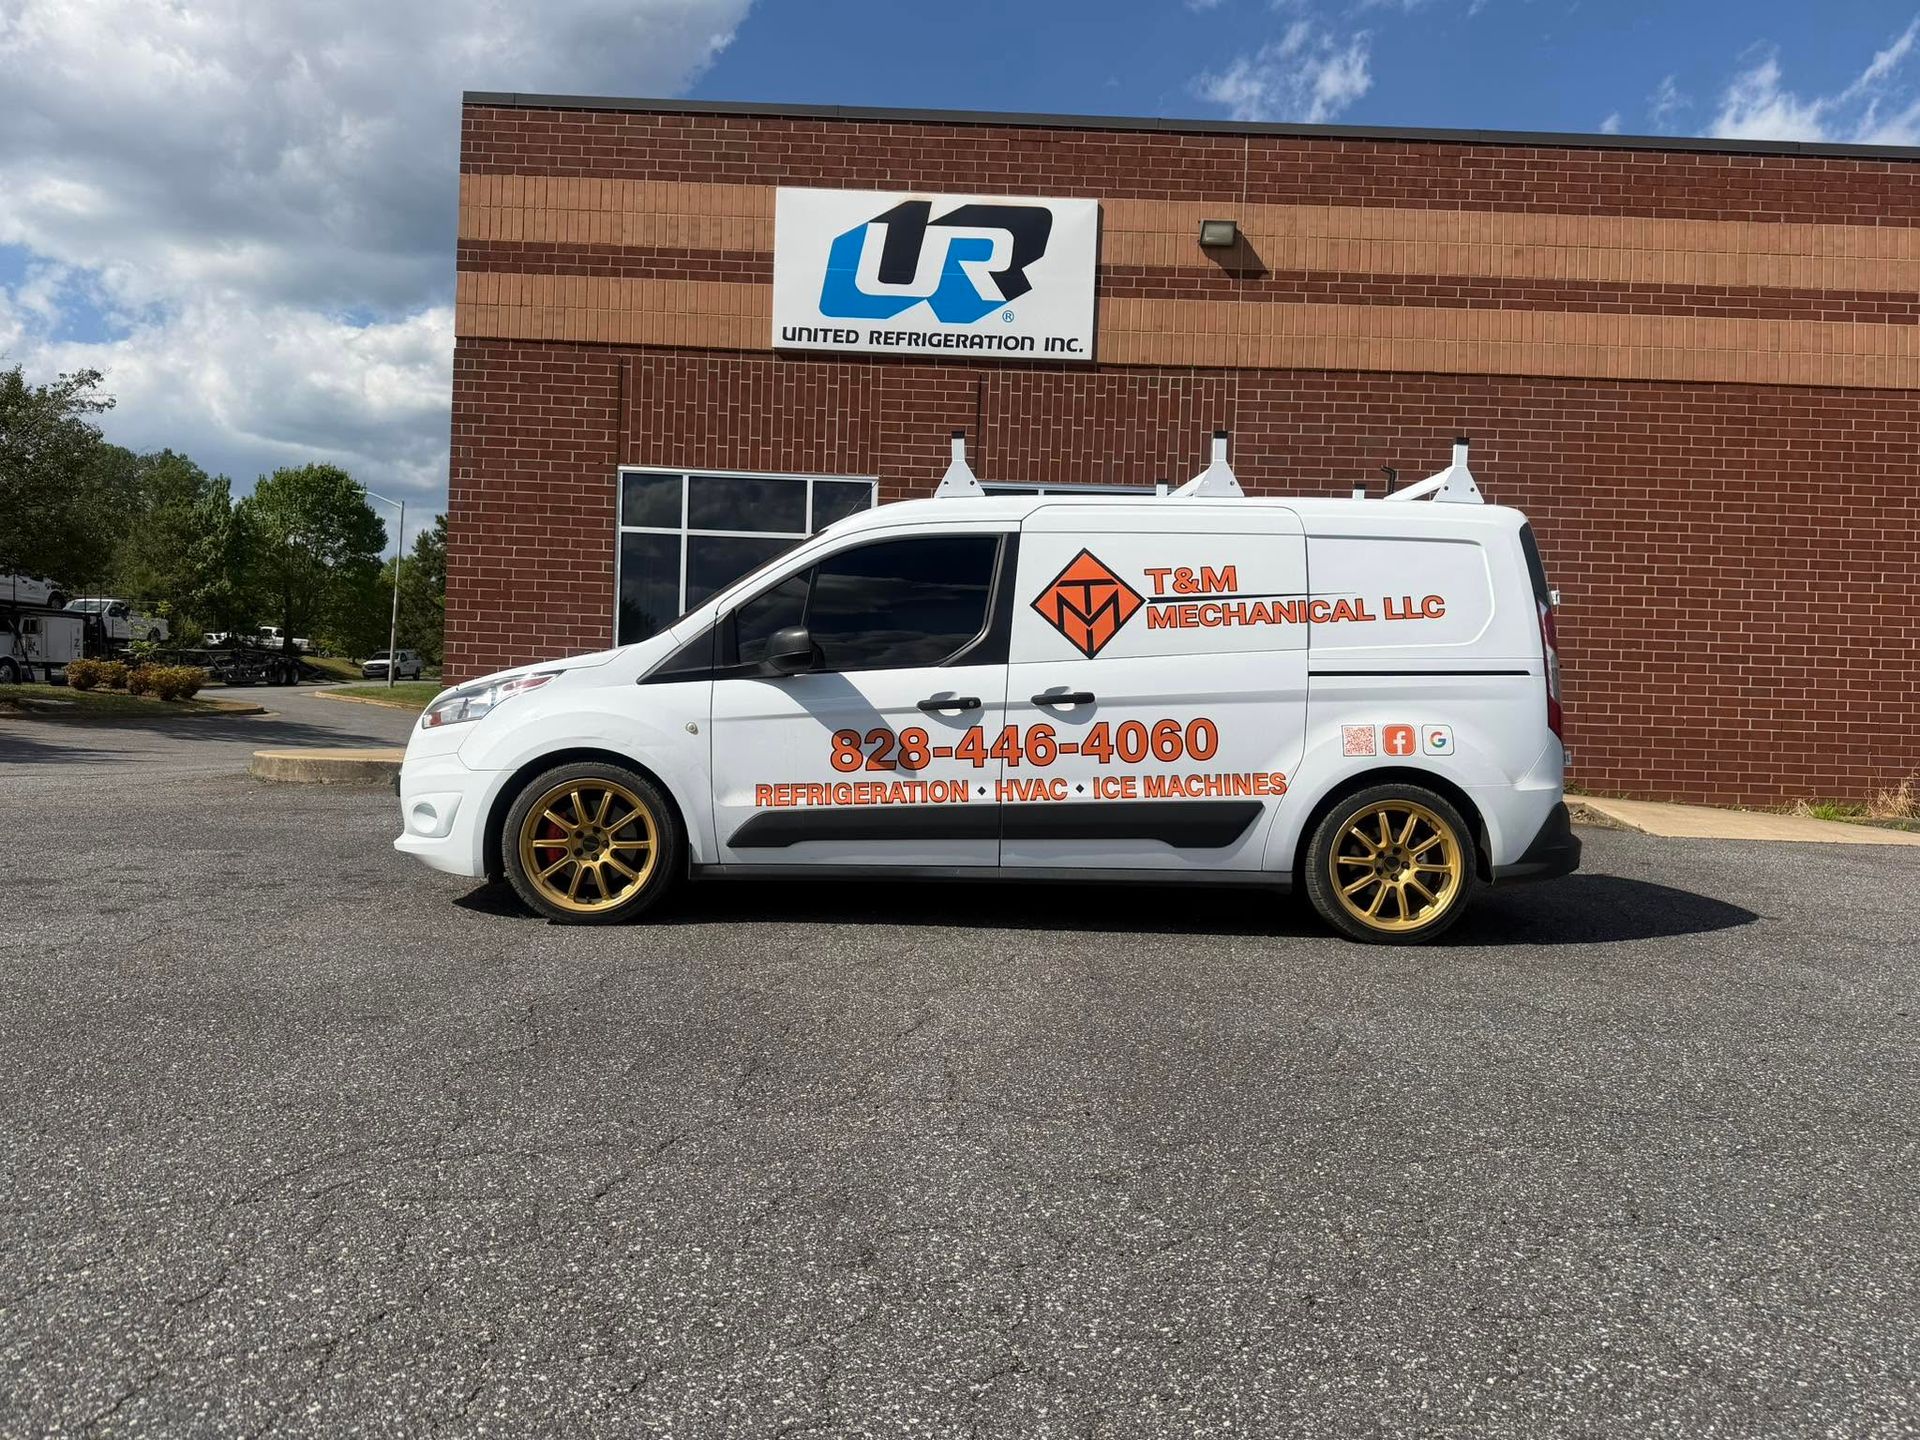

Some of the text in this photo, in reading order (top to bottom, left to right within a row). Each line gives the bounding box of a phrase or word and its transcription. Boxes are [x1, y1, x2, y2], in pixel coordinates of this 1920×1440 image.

[781, 326, 1084, 353] UNITED REFRIGERATION INC.
[1144, 565, 1238, 595] T&M
[1146, 595, 1446, 630] MECHANICAL LLC
[829, 717, 1220, 773] 828-446-4060
[755, 772, 1288, 807] REFRIGERATION HVAC ICE MACHINES
